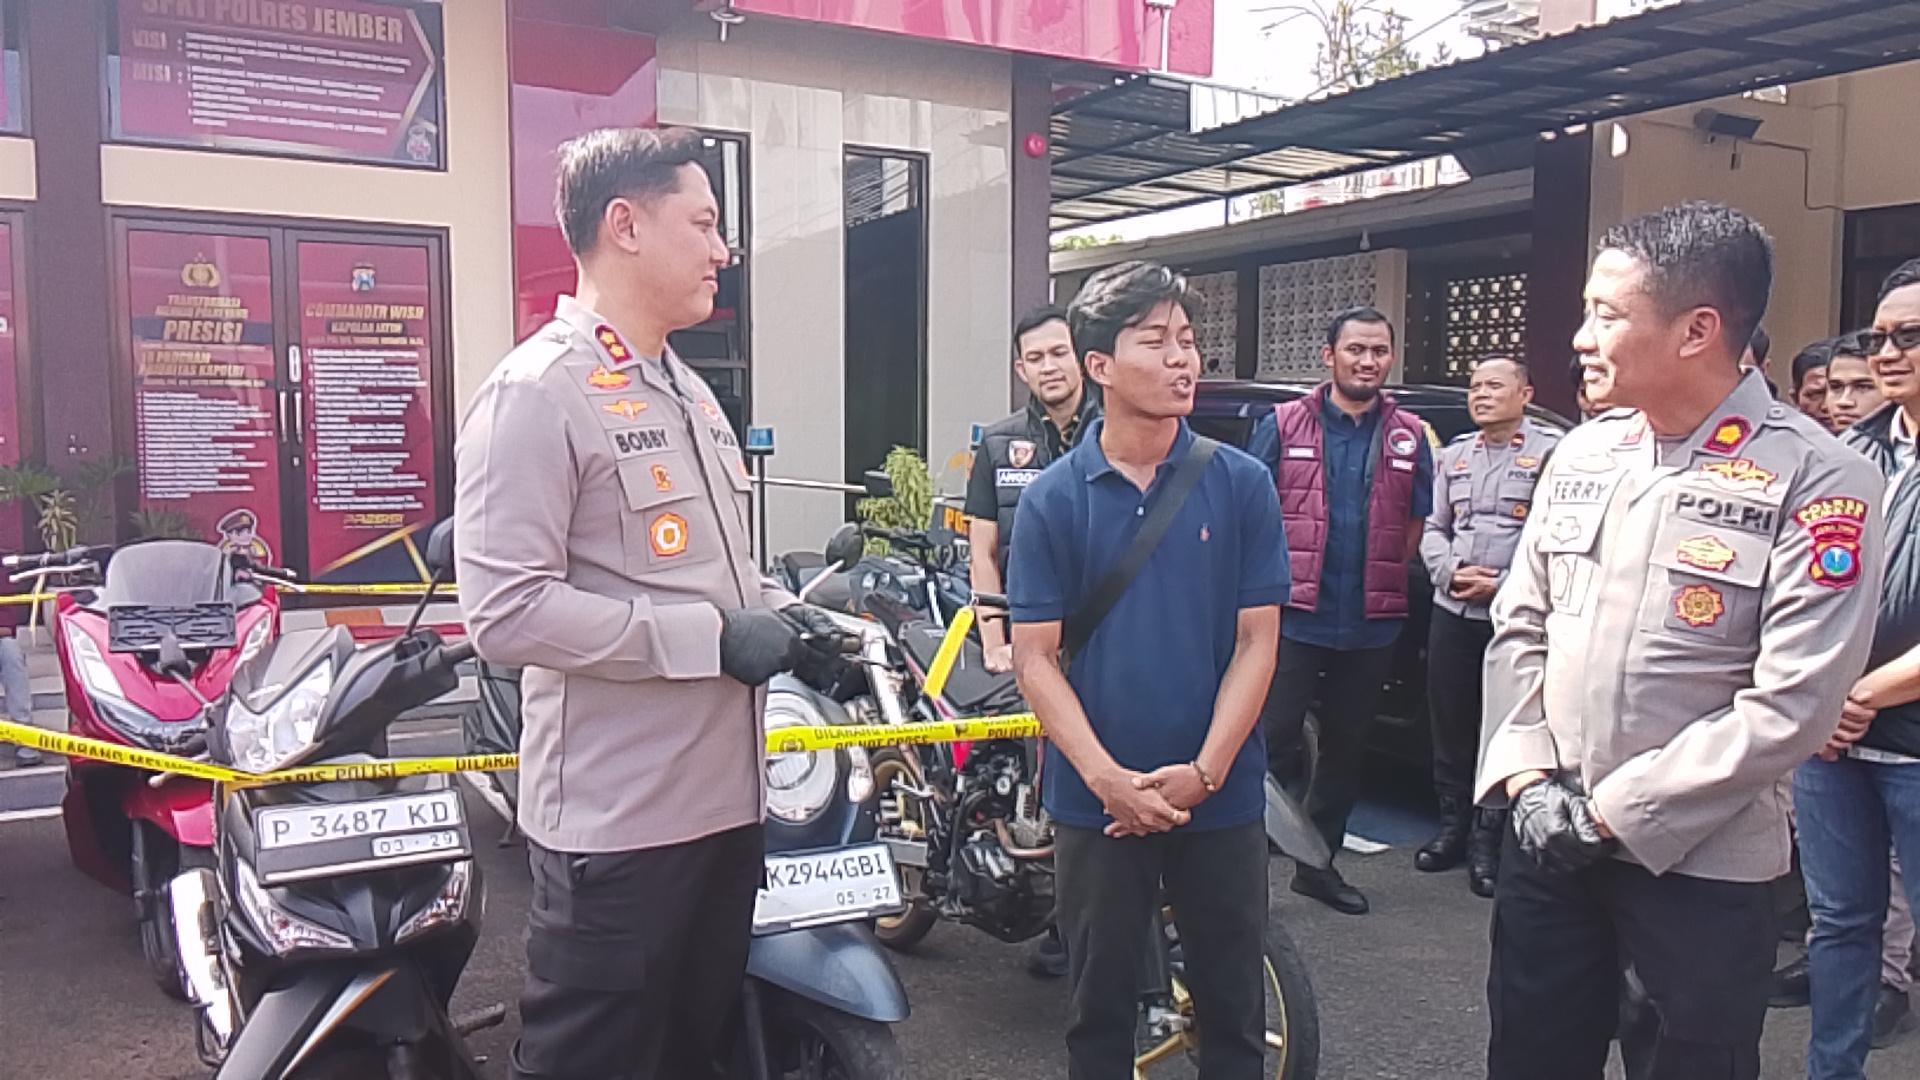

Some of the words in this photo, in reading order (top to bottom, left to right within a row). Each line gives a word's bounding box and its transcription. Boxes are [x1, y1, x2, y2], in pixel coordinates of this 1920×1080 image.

[215, 0, 307, 31] POLRES
[312, 7, 403, 44] JEMBER
[164, 320, 243, 342] PRESISI
[614, 428, 669, 453] BOBBY
[1676, 492, 1773, 531] POLRI
[336, 762, 397, 780] POLISI
[272, 819, 290, 843] P
[311, 808, 388, 837] 3487
[408, 801, 450, 826] KD
